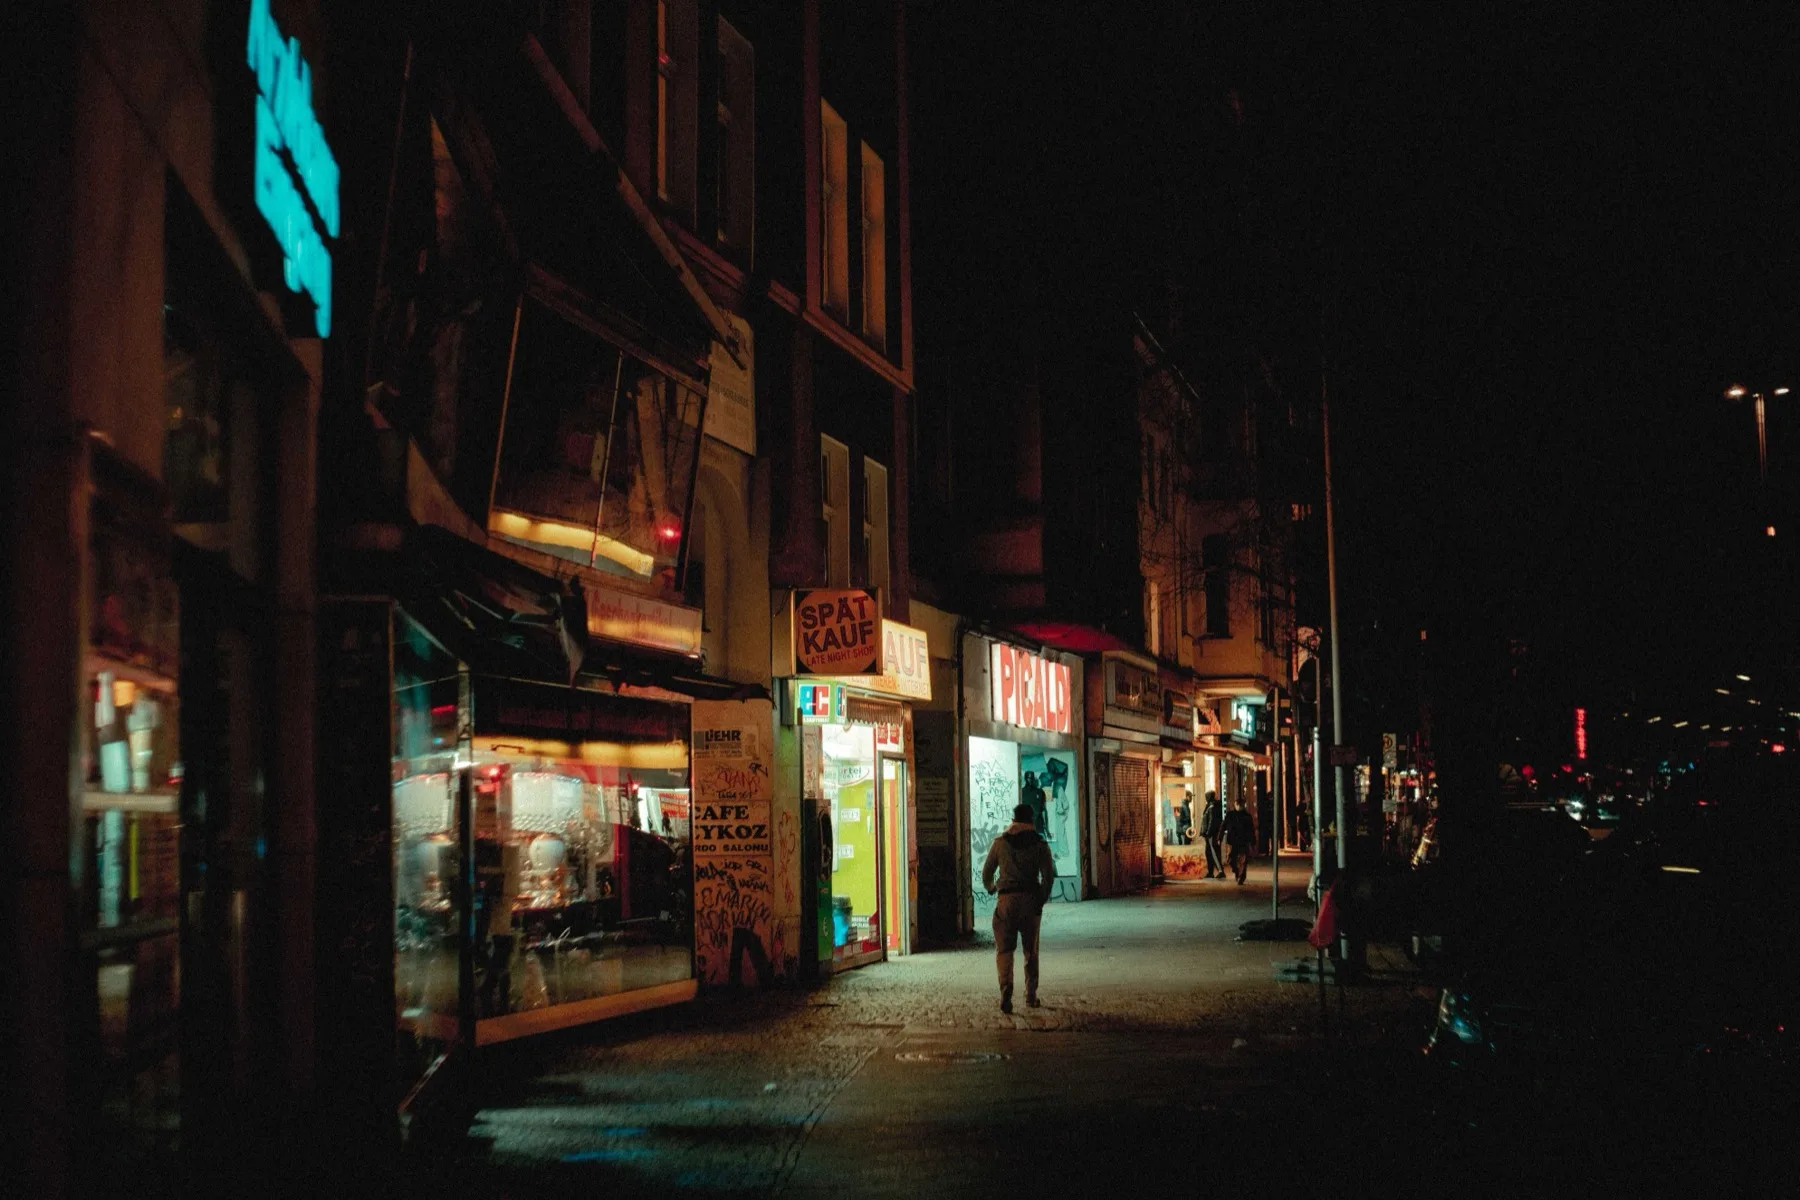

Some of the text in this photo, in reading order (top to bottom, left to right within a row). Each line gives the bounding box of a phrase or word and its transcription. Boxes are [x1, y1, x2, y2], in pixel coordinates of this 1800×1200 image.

[801, 595, 869, 630] SPÄT
[802, 620, 874, 655] KAUF
[806, 645, 874, 667] LATE NIGHT SHOP
[1000, 643, 1071, 734] PICALDI
[695, 824, 768, 840] YKOZ
